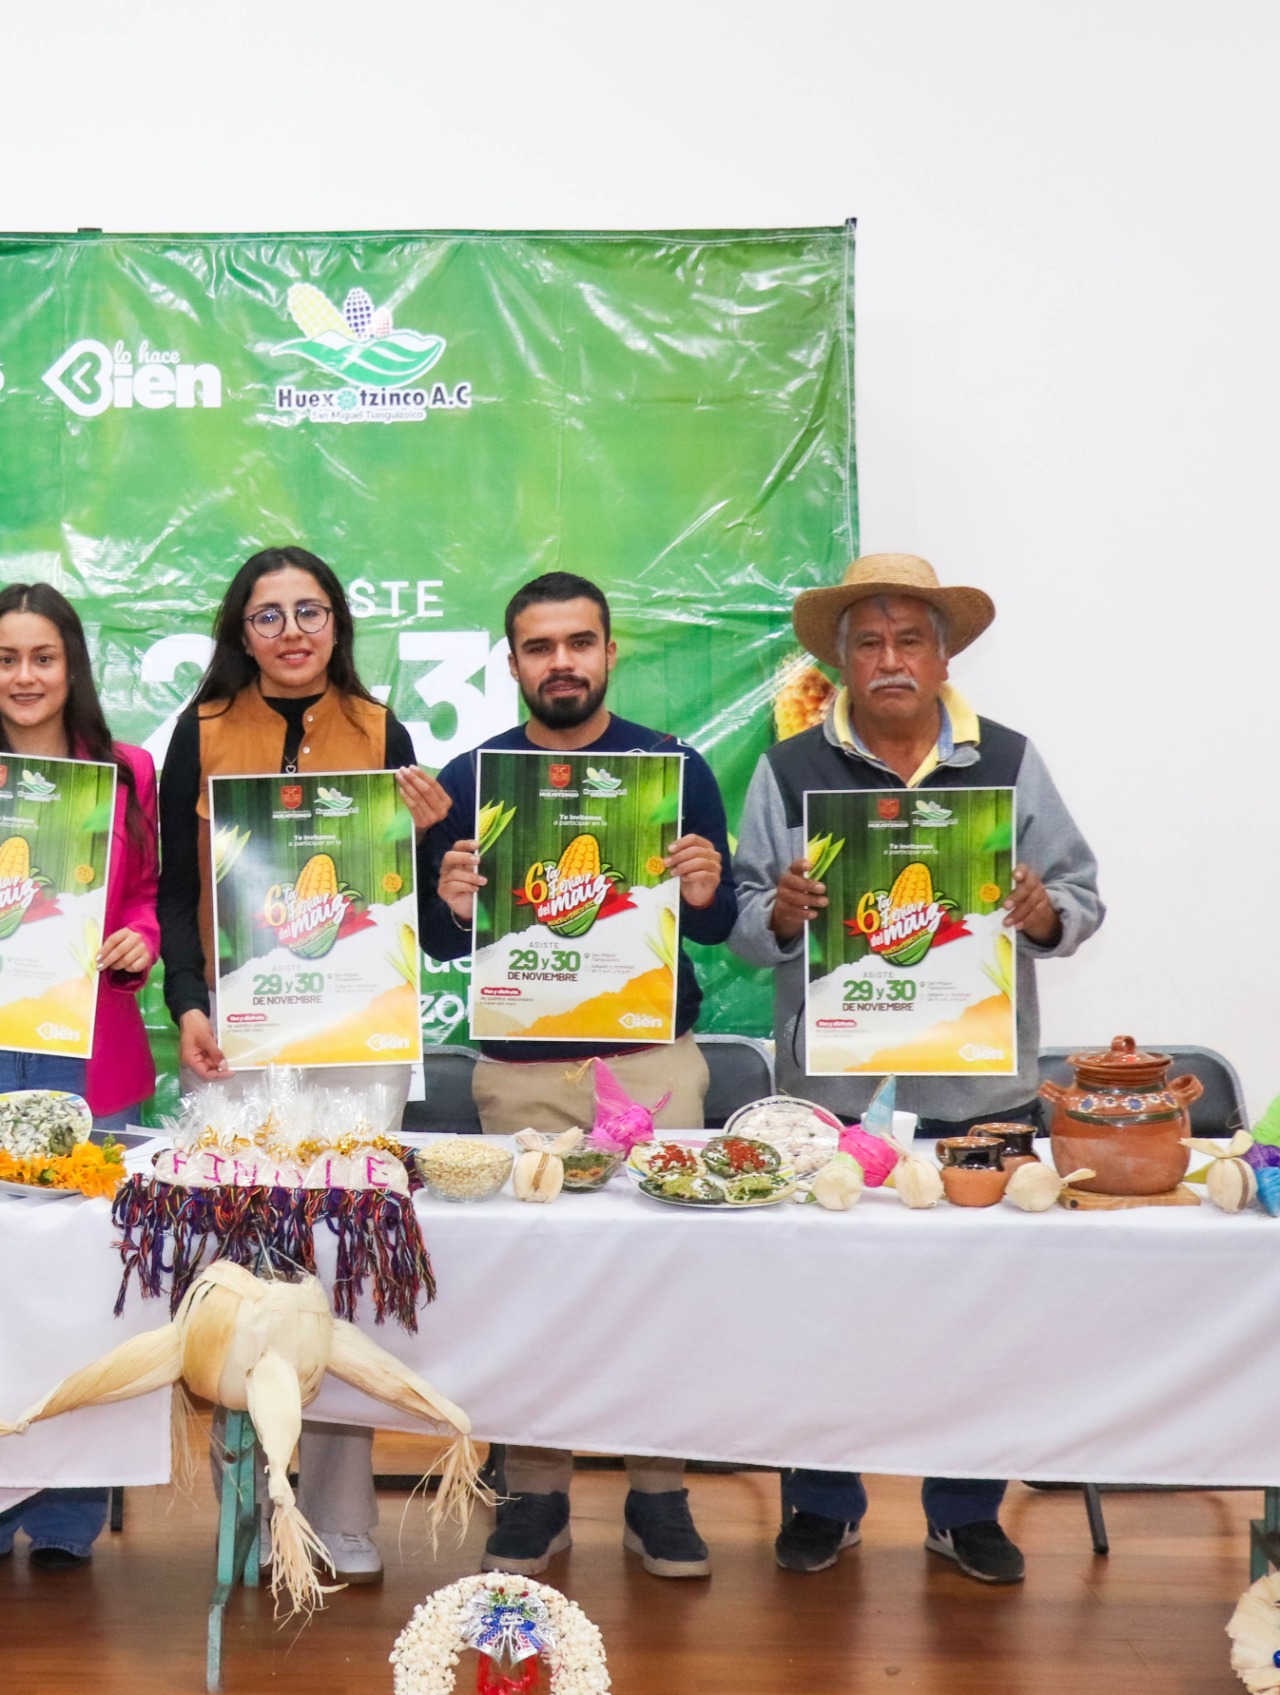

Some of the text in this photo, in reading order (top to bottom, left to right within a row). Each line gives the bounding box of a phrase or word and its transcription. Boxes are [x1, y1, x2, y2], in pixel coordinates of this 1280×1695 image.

[113, 340, 180, 363] lo hace
[312, 410, 329, 420] San
[331, 410, 364, 422] Miguel
[538, 902, 550, 917] del
[279, 926, 291, 941] del
[870, 931, 884, 947] del
[272, 964, 301, 972] ASISTE
[509, 949, 538, 971] 29
[541, 958, 549, 970] y
[551, 951, 581, 972] 30
[253, 973, 282, 995] 29
[285, 981, 294, 994] y
[295, 972, 324, 993] 30
[508, 971, 578, 982] DE NOVIEMBRE
[843, 979, 873, 1001] 29
[876, 986, 884, 1000] y
[886, 979, 916, 1001] 30
[253, 995, 322, 1006] DE NOVIEMBRE
[843, 1003, 914, 1012] DE NOVIEMBRE
